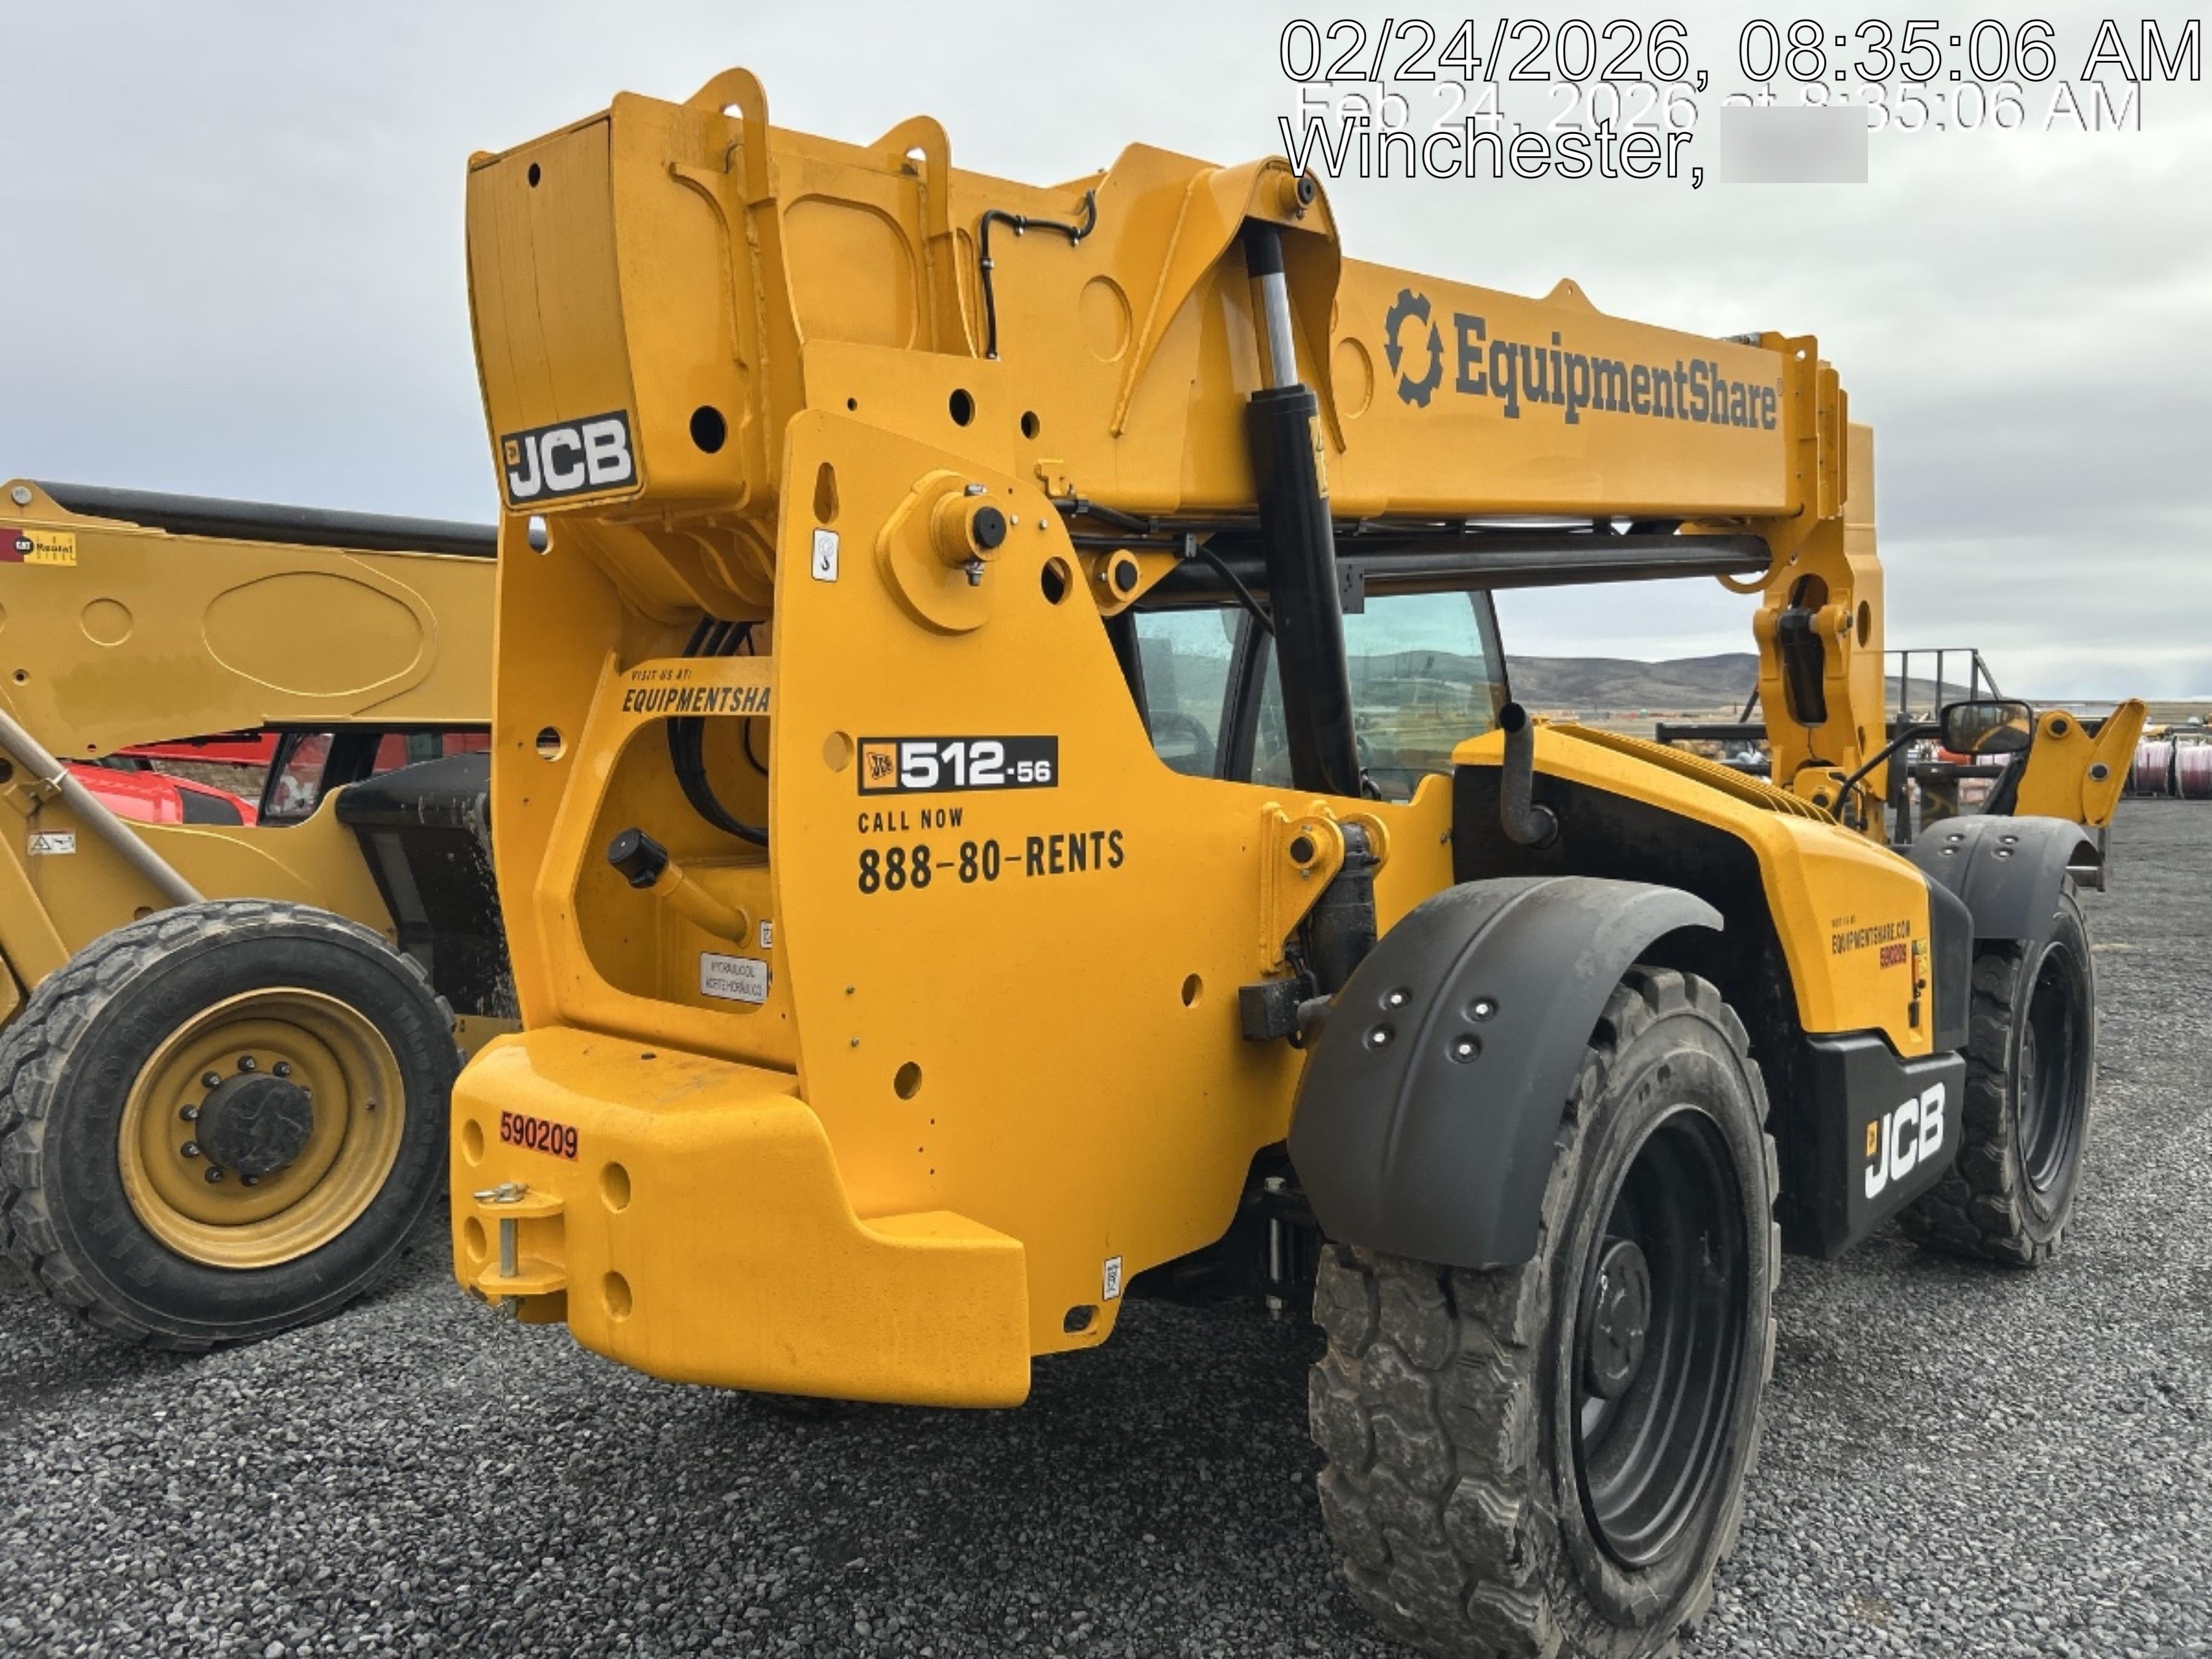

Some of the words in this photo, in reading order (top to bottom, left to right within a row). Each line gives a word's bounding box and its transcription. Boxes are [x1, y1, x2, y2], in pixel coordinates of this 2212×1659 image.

[1454, 312, 1777, 430] EquipmentShare
[509, 420, 632, 497] JCB
[622, 687, 771, 713] EQUIPMENTSHA
[900, 740, 1051, 788] 512-56
[858, 810, 910, 834] CALL
[921, 807, 963, 829] NOW
[858, 830, 1124, 895] 888-80-RENTS
[501, 1110, 578, 1158] 590209
[1865, 1081, 1945, 1199] JCB
